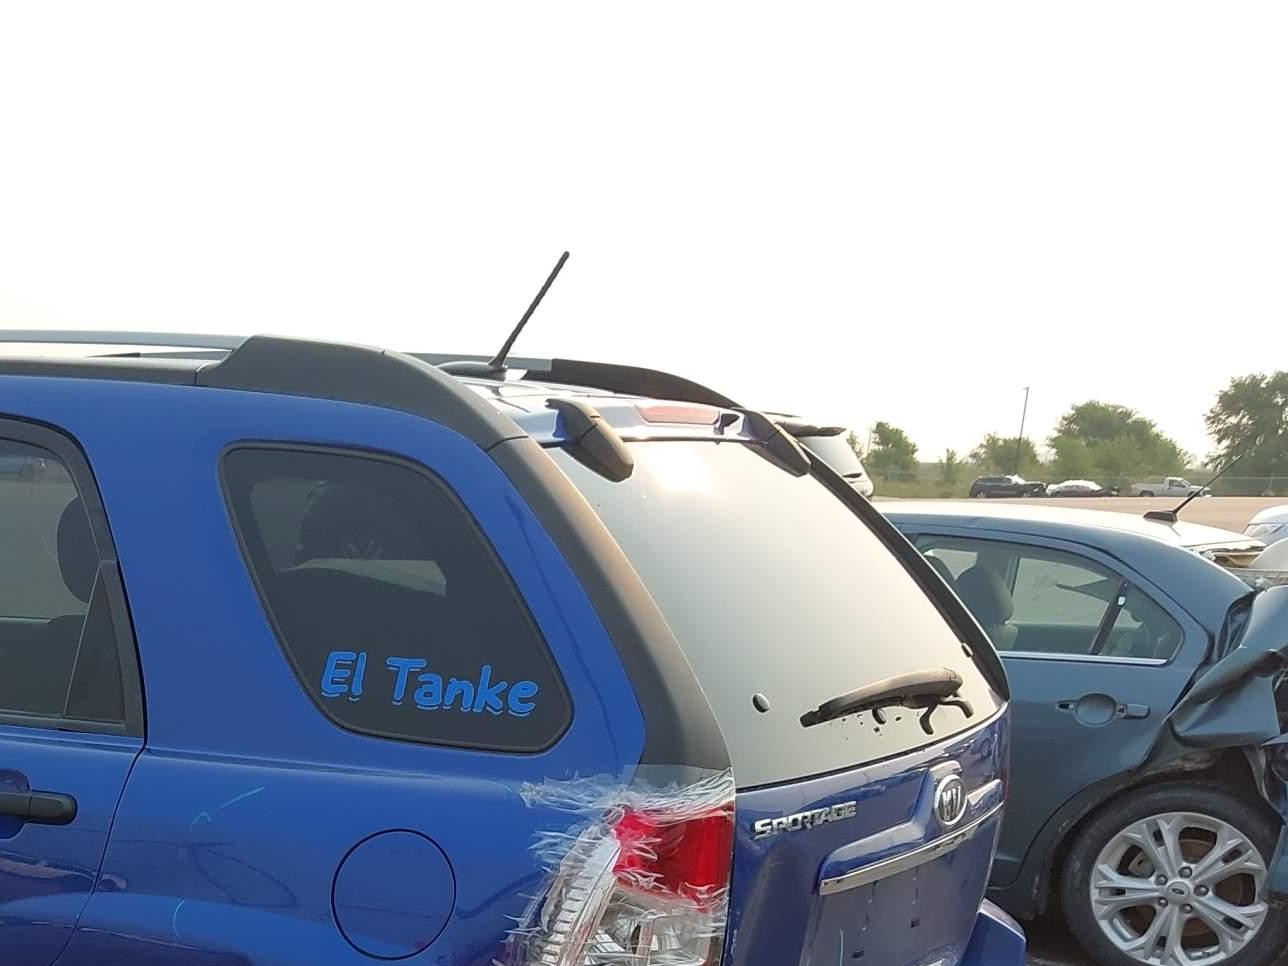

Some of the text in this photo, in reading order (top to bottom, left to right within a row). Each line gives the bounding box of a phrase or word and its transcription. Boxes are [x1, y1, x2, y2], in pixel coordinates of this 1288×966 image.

[320, 651, 538, 717] El Tanke
[754, 800, 857, 840] SPORTAGE
